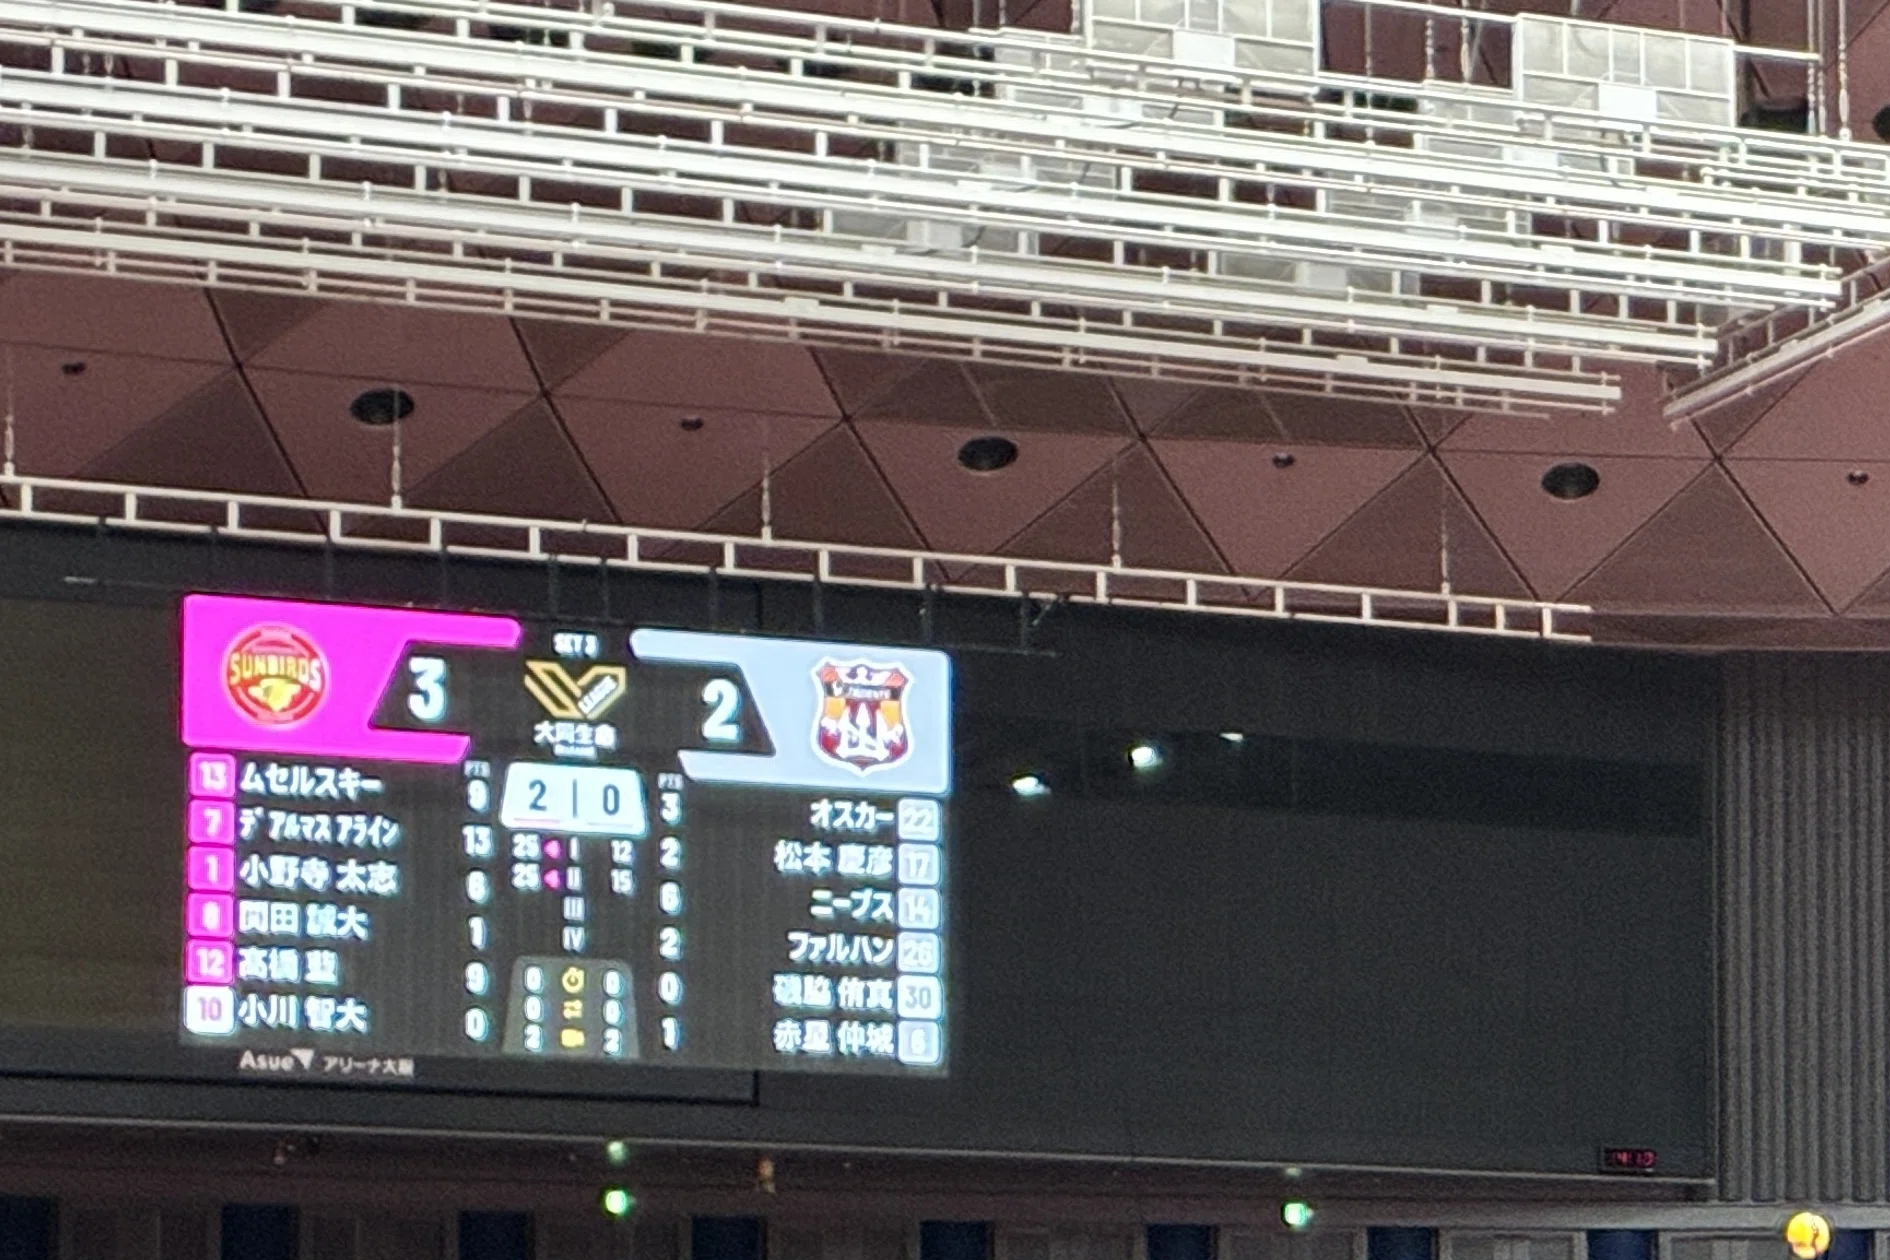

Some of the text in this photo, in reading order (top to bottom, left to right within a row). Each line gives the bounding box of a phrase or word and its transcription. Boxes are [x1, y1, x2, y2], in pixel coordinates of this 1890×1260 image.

[229, 652, 322, 693] SUNBIRDS
[408, 656, 447, 721] 3
[702, 678, 740, 742] 2
[240, 760, 384, 798] ムセルスキー
[528, 779, 621, 816] 2 0
[660, 791, 682, 825] 3
[810, 798, 895, 830] オスカー
[204, 809, 222, 837] 7
[335, 814, 401, 848] アライン
[462, 825, 493, 857] 13
[611, 839, 634, 865] 12
[659, 836, 682, 869] 2
[774, 839, 833, 875] 松本
[907, 850, 930, 879] 17
[238, 853, 333, 892] 小野寺
[335, 857, 400, 895] 太志
[611, 868, 634, 895] 15
[468, 916, 487, 950] 1
[659, 926, 682, 960] 2
[787, 931, 894, 963] ファルハン
[197, 949, 225, 977] 12
[465, 961, 488, 996] 9
[524, 966, 624, 997] 0 0
[658, 971, 684, 1006] 0
[904, 984, 932, 1009] 30
[198, 993, 368, 1033] 10 小川 智大
[464, 1007, 488, 1042] 0
[524, 995, 624, 1027] 0 0
[524, 1024, 623, 1055] 2 2
[661, 1016, 679, 1051] 1
[773, 1018, 831, 1051] 赤星
[239, 1050, 414, 1077] Asue アリーナ大阪
